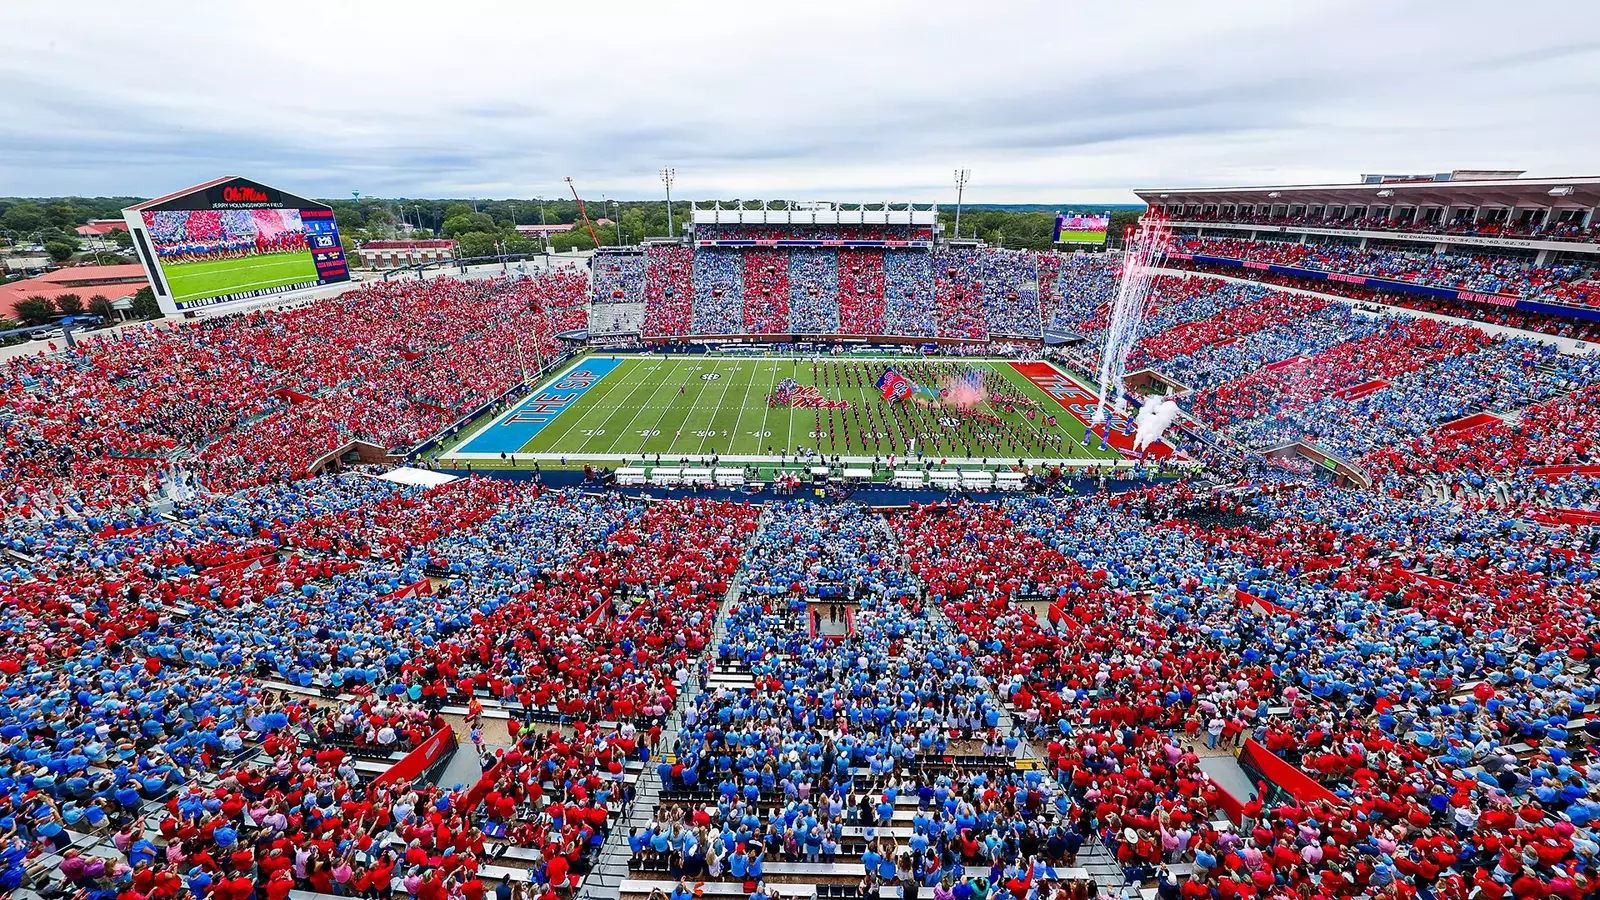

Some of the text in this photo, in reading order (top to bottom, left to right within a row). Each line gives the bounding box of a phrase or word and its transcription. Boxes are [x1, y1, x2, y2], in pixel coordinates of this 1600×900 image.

[224, 186, 268, 201] Ole Miss
[182, 298, 217, 309] WELCOME
[294, 280, 318, 290] STADIUM
[1457, 291, 1518, 308] LOCK THE VAUGHT!
[1030, 374, 1095, 401] THE
[501, 370, 601, 427] THE SIP
[640, 429, 661, 437] 20
[752, 430, 772, 438] 40
